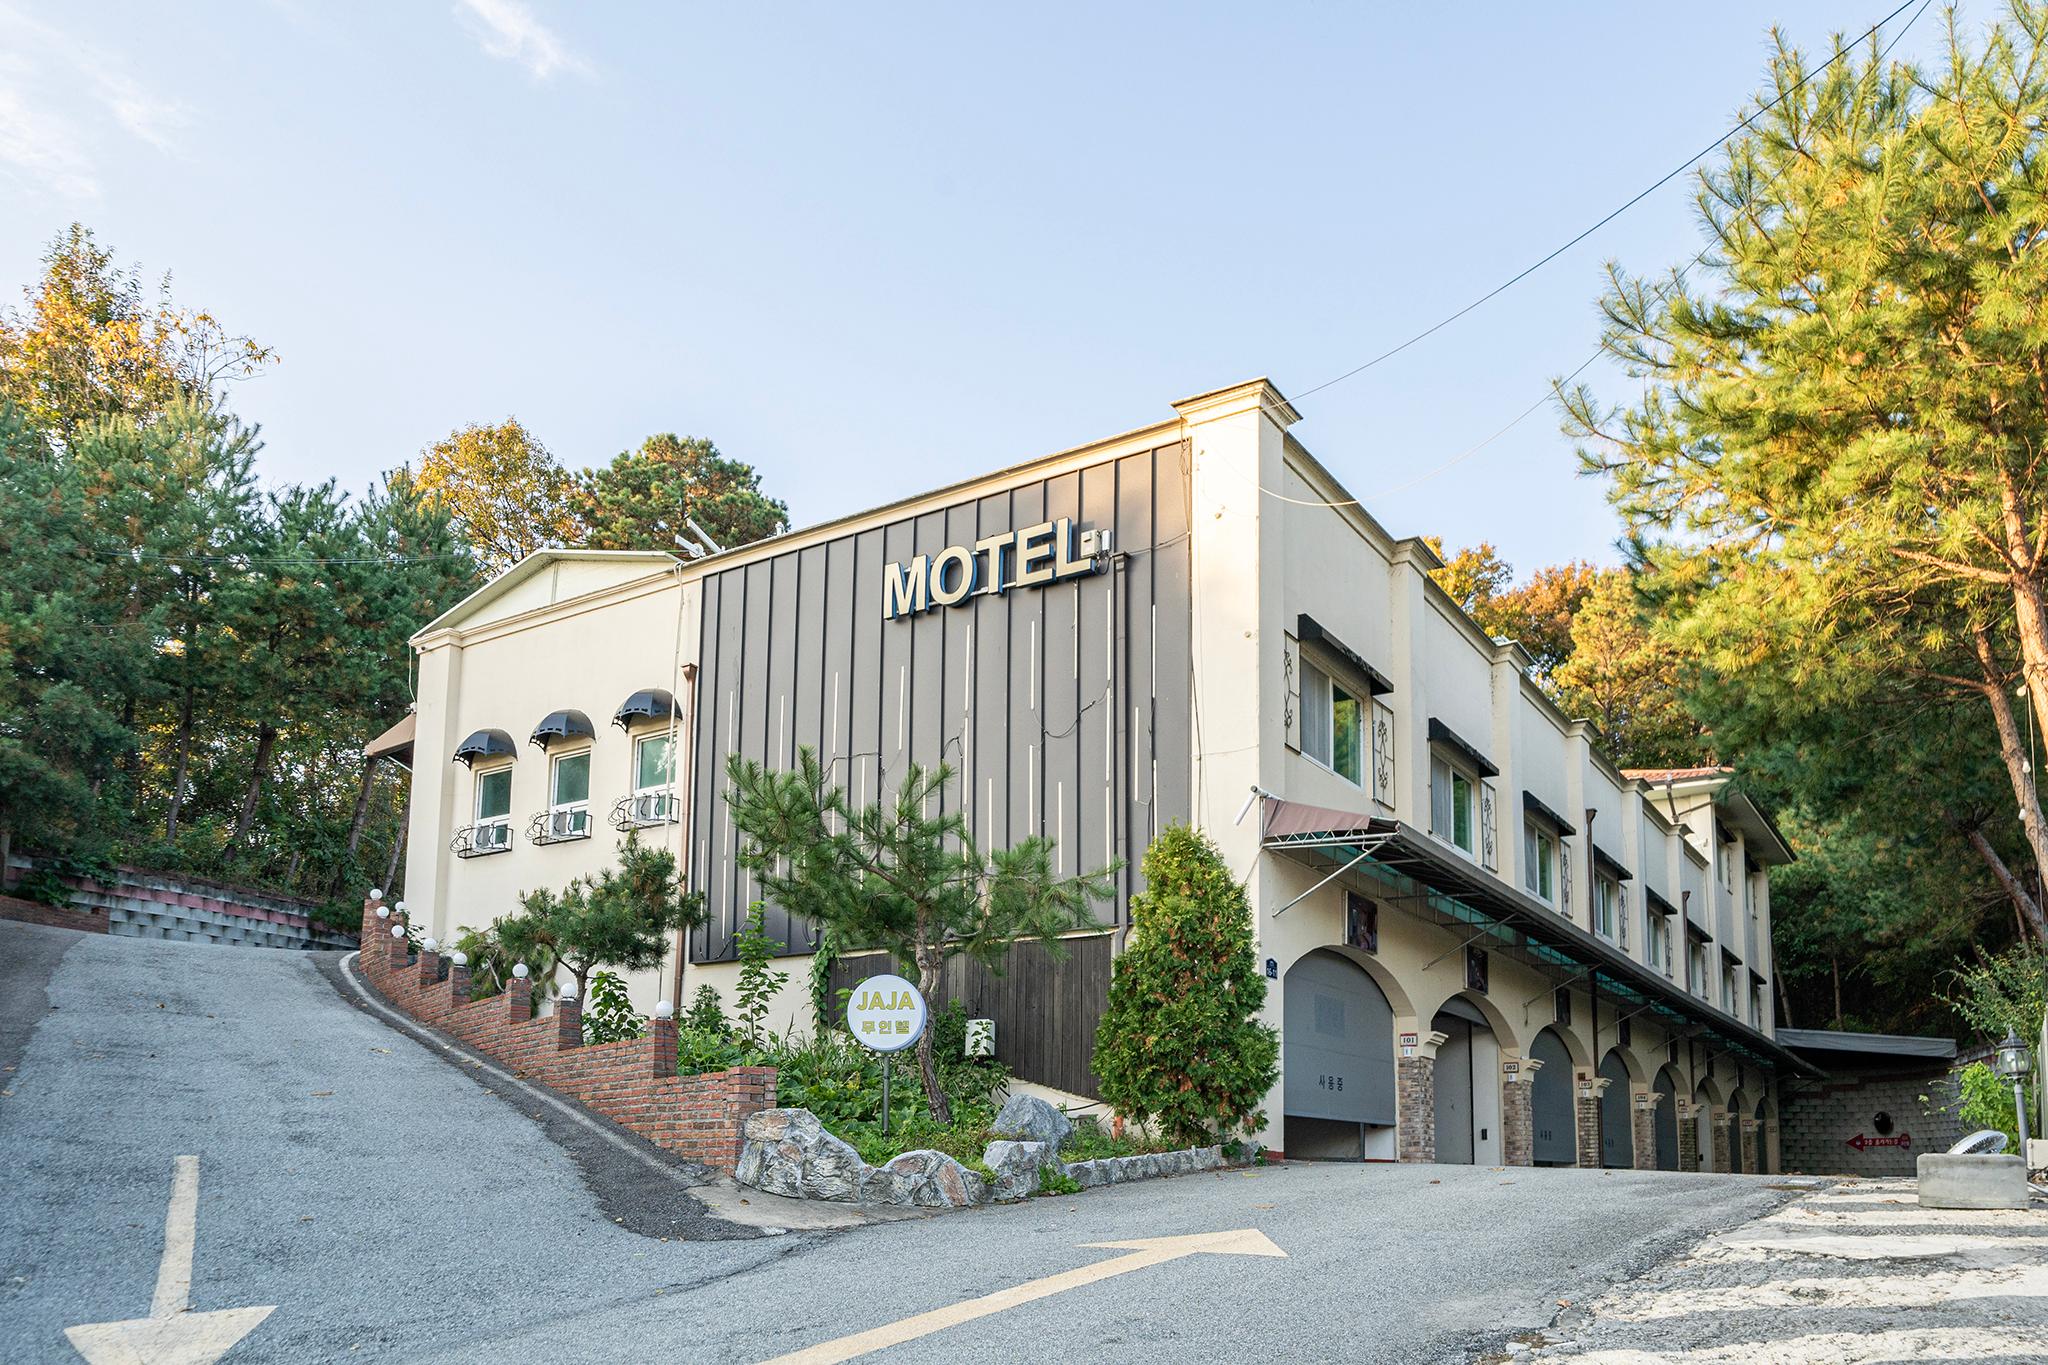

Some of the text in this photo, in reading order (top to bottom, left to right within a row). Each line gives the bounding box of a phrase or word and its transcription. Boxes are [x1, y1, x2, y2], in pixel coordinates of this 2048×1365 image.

[883, 517, 1095, 620] MOTEL
[856, 991, 915, 1011] JAJA
[1402, 1036, 1415, 1044] 101
